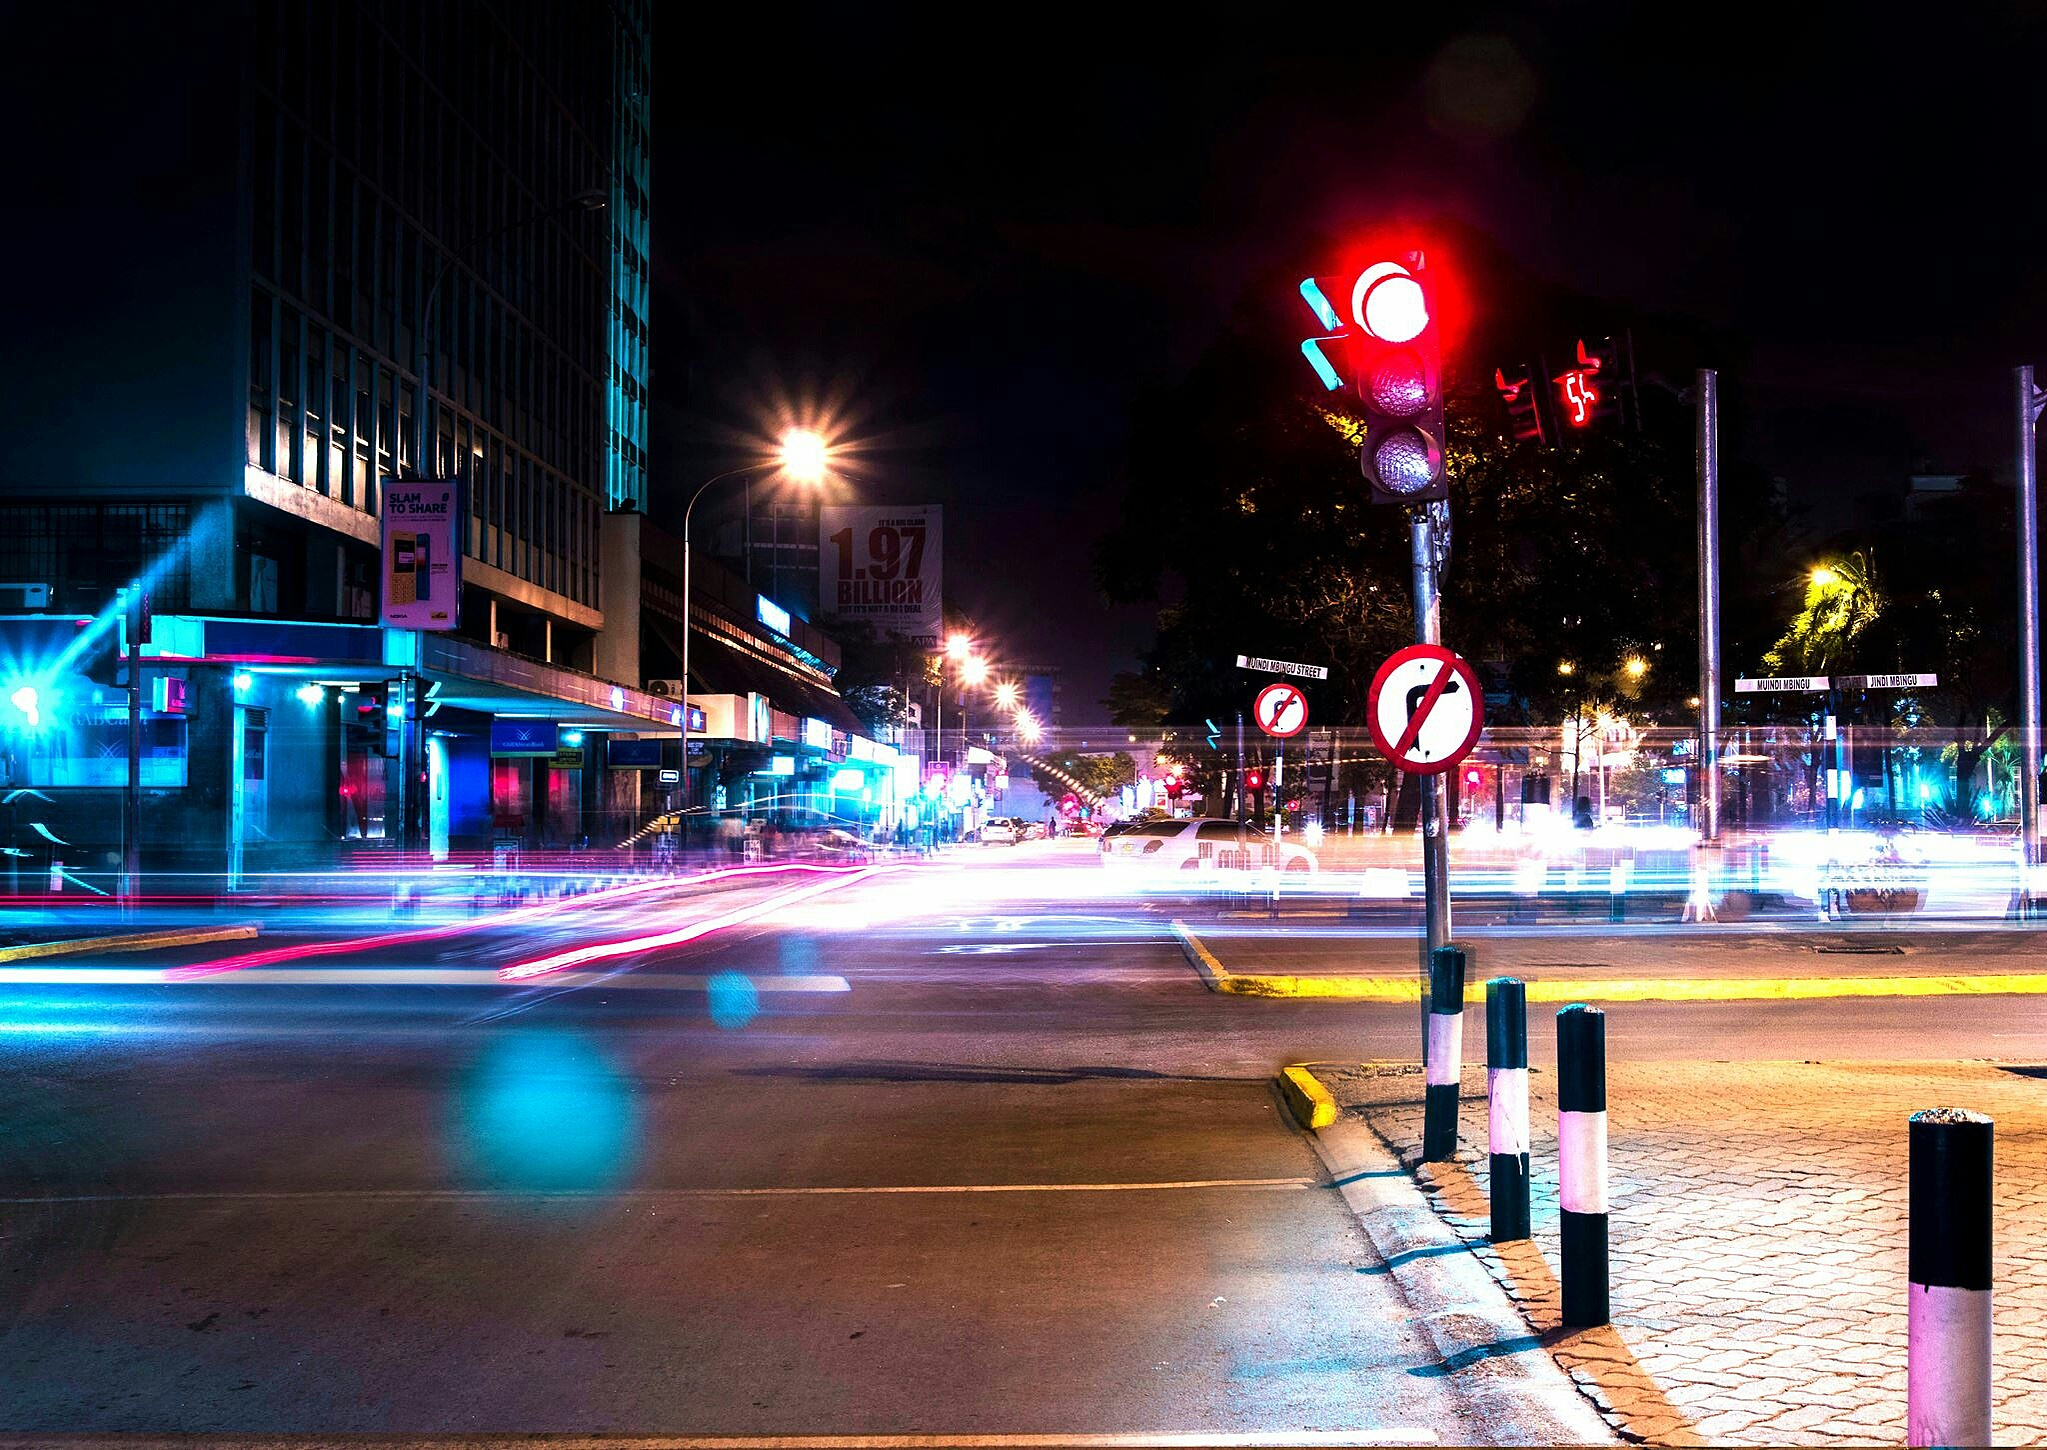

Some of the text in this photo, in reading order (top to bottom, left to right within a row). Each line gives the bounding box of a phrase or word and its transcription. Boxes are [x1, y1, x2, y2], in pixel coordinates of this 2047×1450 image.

[389, 492, 421, 503] SLAM
[389, 503, 448, 513] TO SHARE
[828, 526, 926, 580] 1.97
[837, 579, 923, 605] BILLION
[903, 604, 921, 613] DEAL
[1269, 661, 1296, 674] MBINGU
[1296, 664, 1322, 678] STREET
[1757, 678, 1811, 691] MUINDI MBINGU
[1889, 675, 1917, 686] MBINGU
